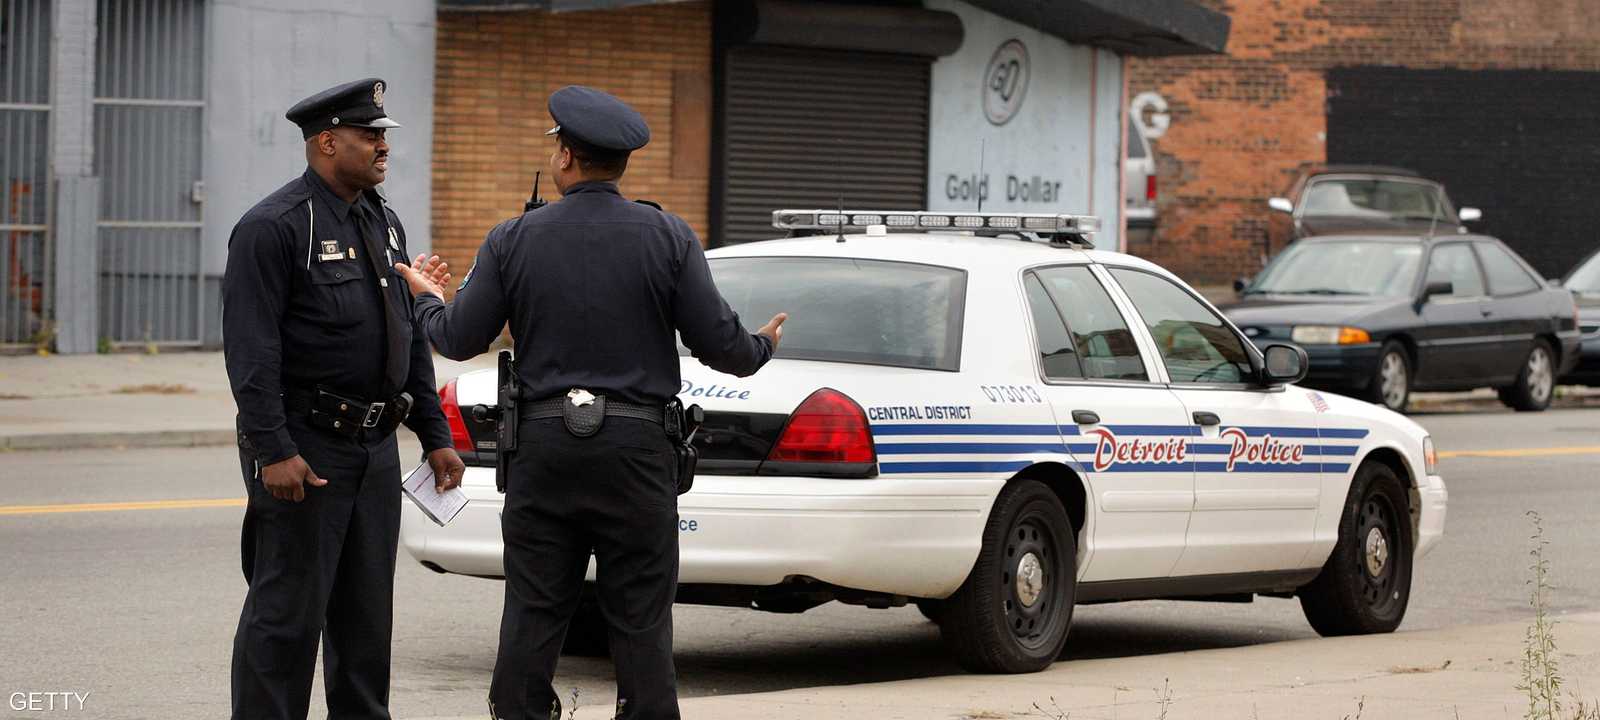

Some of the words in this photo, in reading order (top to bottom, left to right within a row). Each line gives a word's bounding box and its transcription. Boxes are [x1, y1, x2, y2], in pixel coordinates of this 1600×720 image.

[945, 174, 989, 202] Gold
[1006, 175, 1062, 202] Dollar
[980, 385, 1042, 403] 073013
[868, 406, 922, 421] CENTRAL
[925, 405, 972, 420] DISTRICT
[1084, 428, 1187, 471] Detroit
[1220, 427, 1304, 470] Police
